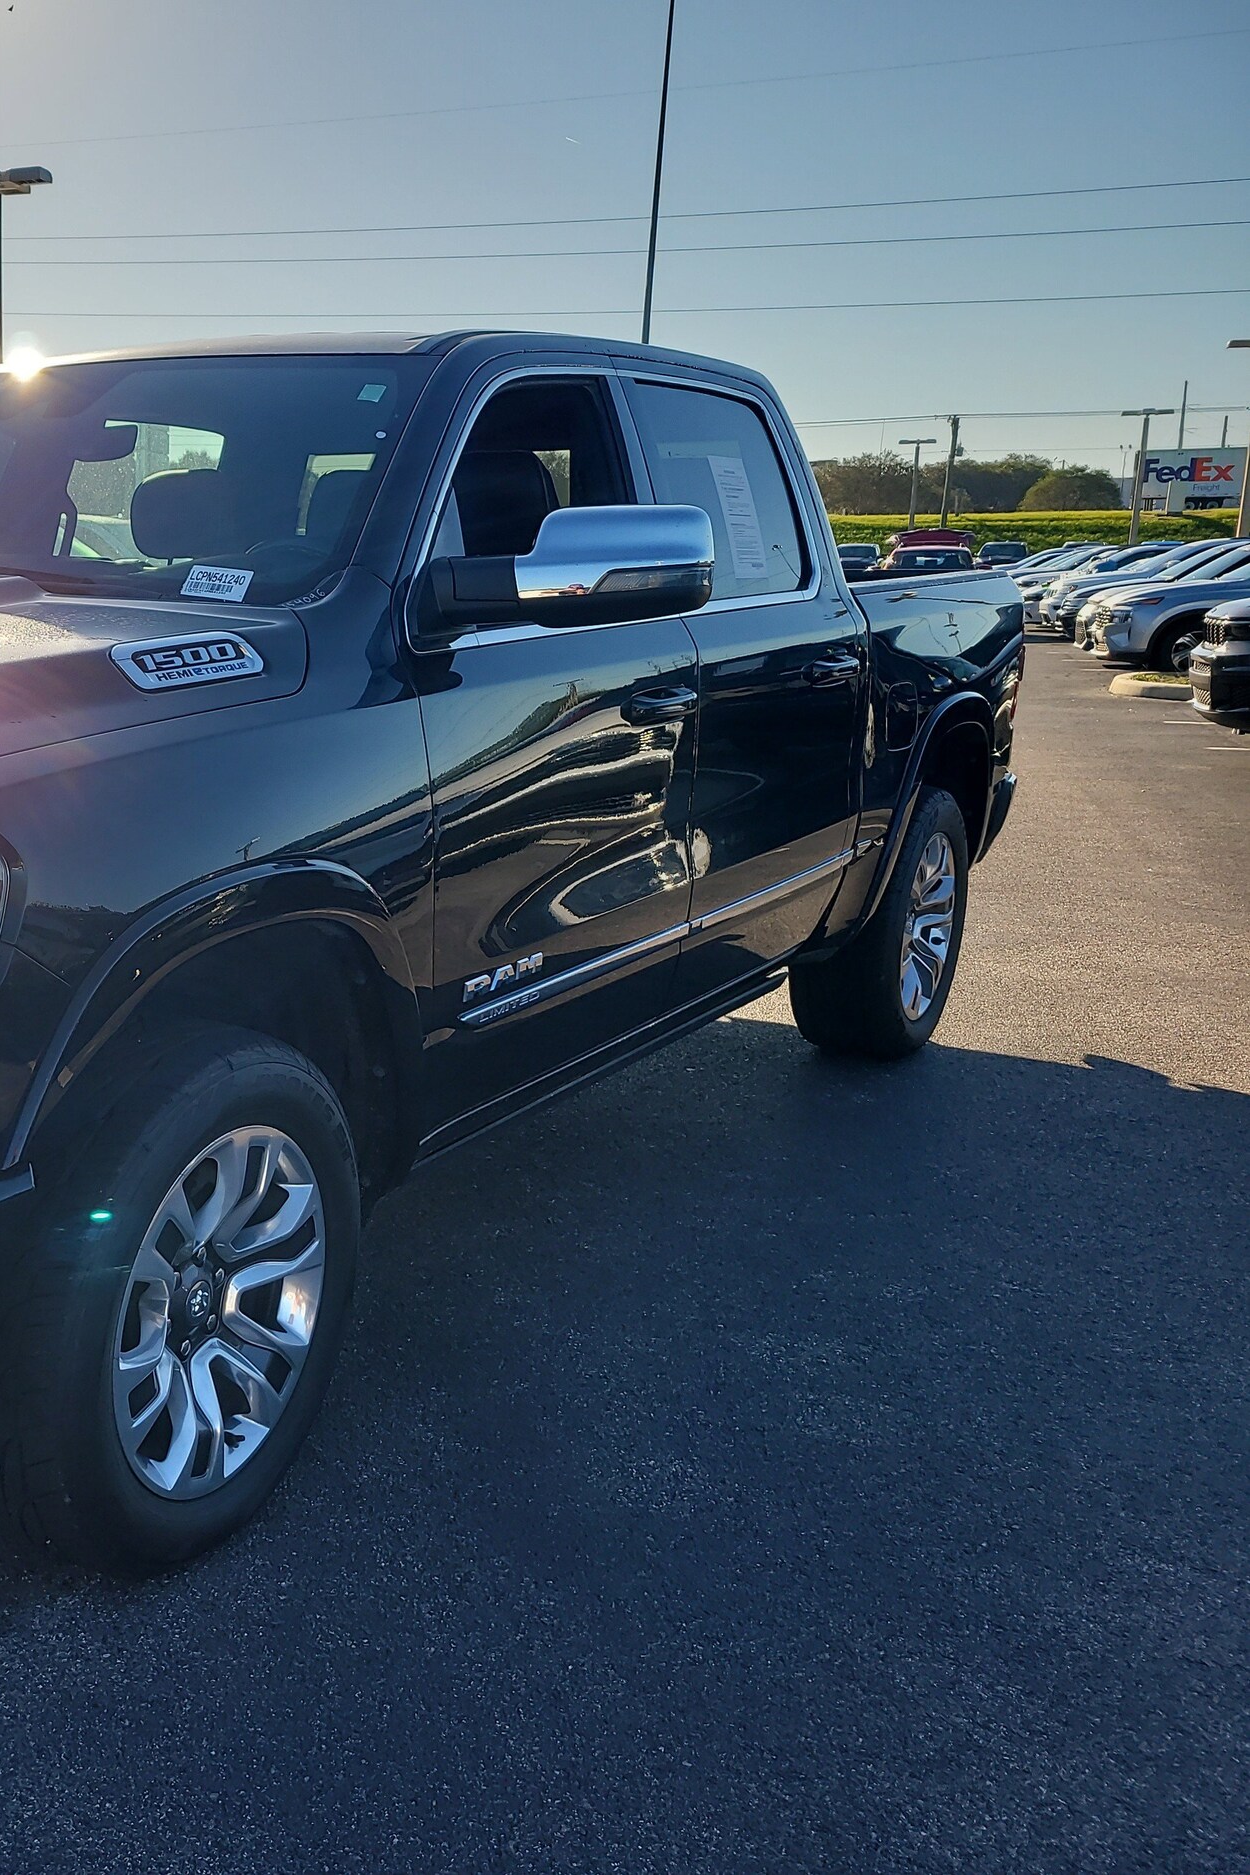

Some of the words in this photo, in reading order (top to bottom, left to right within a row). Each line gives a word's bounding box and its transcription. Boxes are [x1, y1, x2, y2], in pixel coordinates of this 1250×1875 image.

[1143, 456, 1235, 483] FedEx
[1192, 483, 1220, 491] Freight
[190, 570, 246, 586] LCPN541240
[136, 643, 237, 671] 1500
[463, 951, 544, 1003] RAM
[479, 991, 540, 1023] LIMITED
